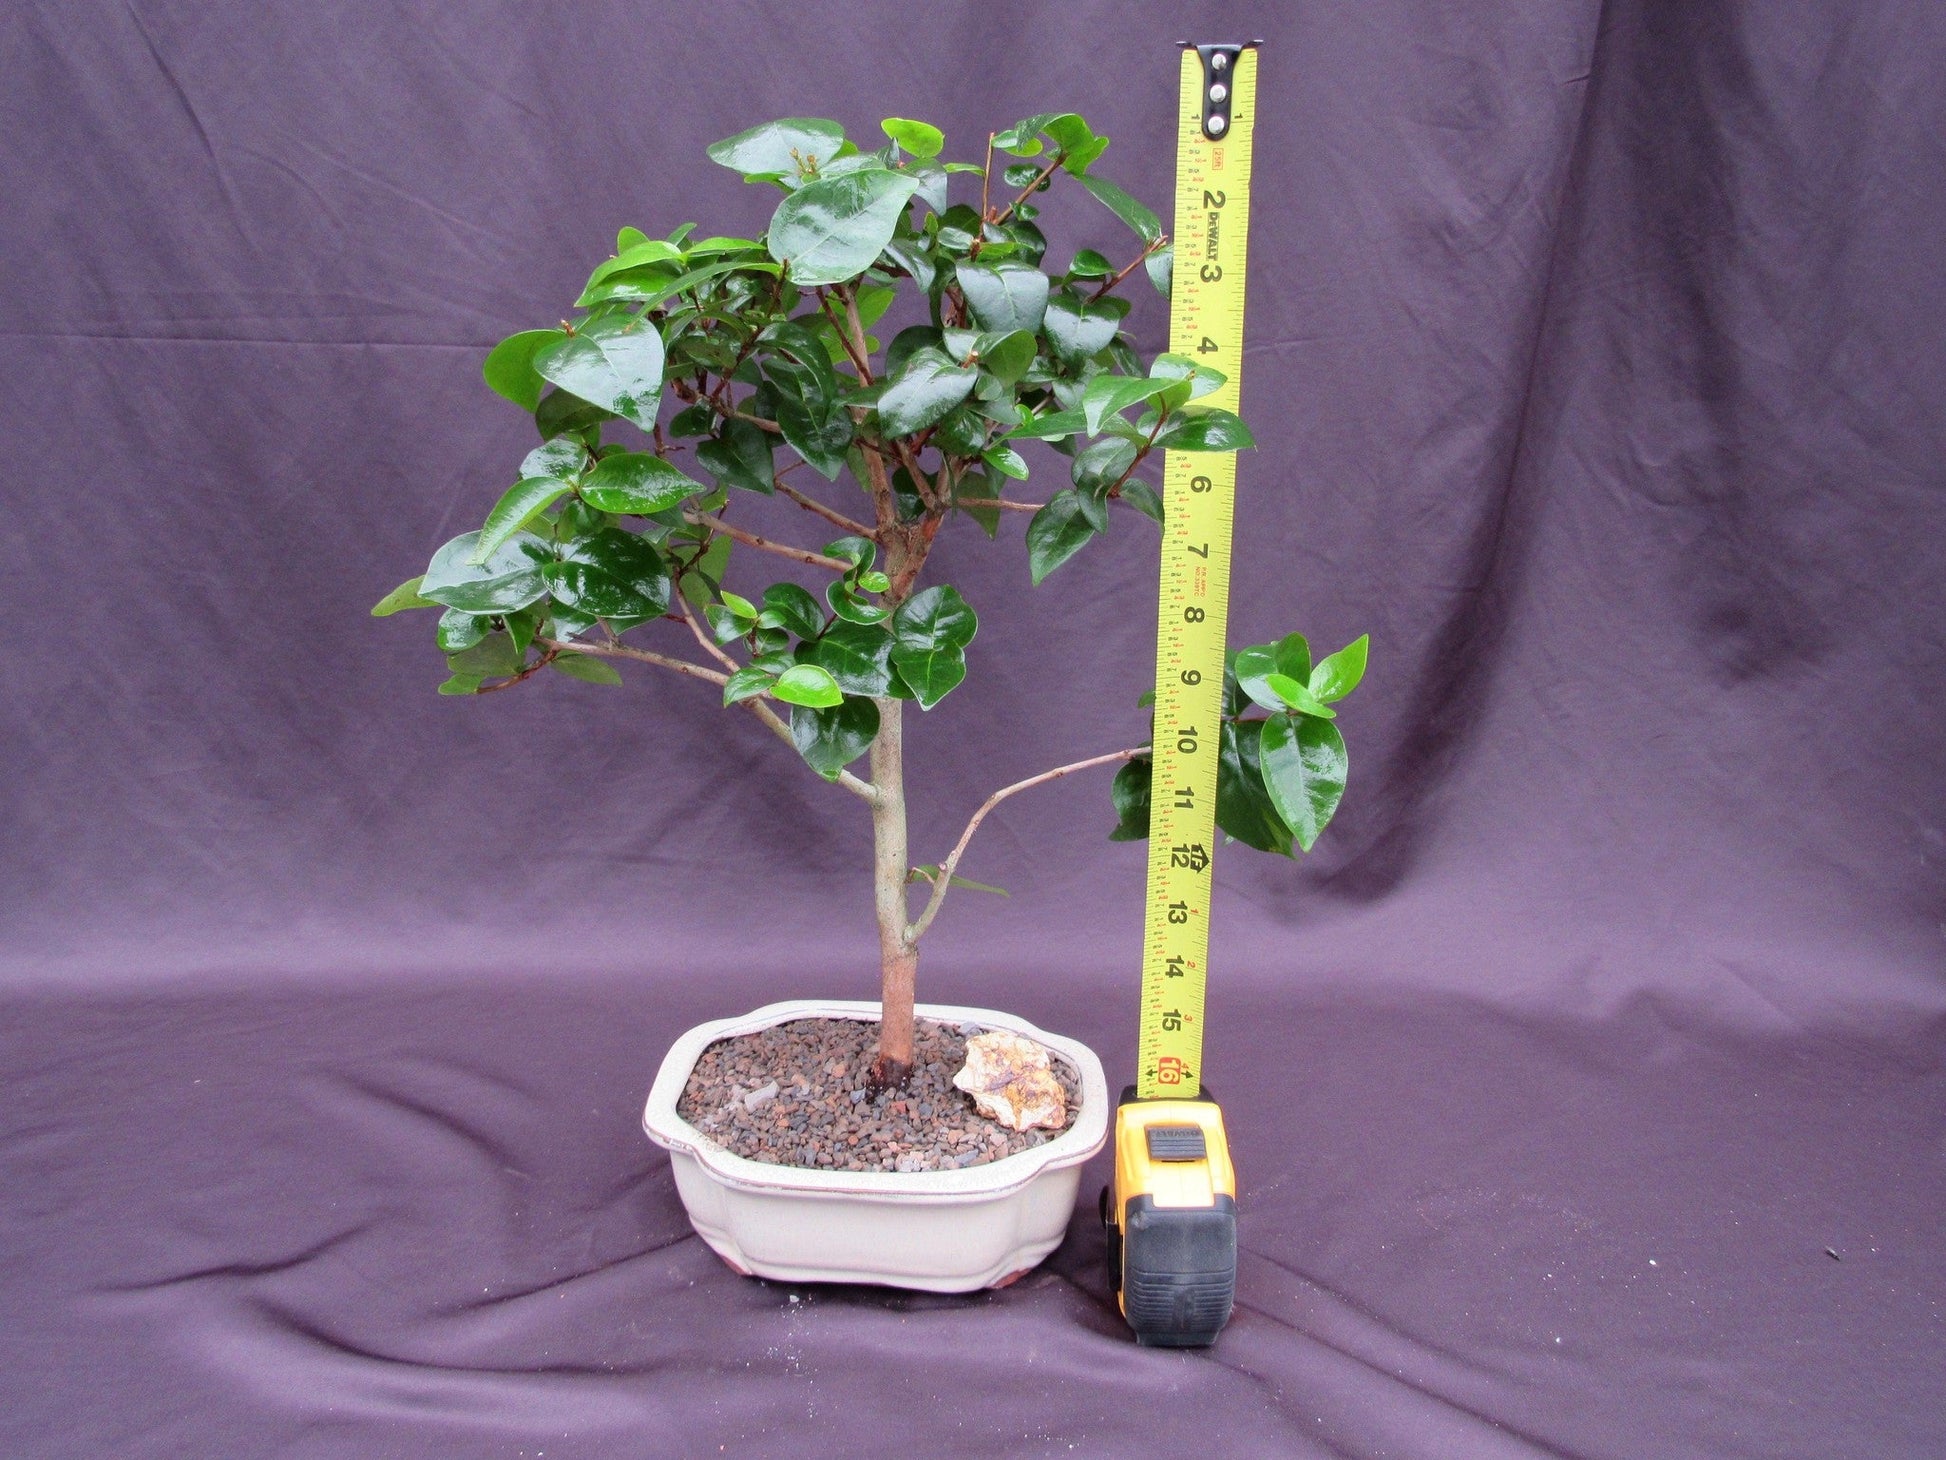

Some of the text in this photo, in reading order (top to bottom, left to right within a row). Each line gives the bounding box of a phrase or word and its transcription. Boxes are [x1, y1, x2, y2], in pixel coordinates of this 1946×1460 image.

[1203, 190, 1226, 209] 2
[1200, 264, 1223, 283] 3
[1197, 336, 1218, 354] 4
[1190, 476, 1212, 493] 6
[1187, 543, 1208, 559] 7
[1184, 606, 1205, 623] 8
[1181, 670, 1201, 686] 9
[1177, 726, 1198, 754] 10
[1174, 786, 1194, 809] 11
[1171, 843, 1190, 868] 12
[1168, 900, 1188, 924] 13
[1165, 955, 1184, 978] 14
[1162, 1008, 1181, 1032] 15
[1159, 1059, 1180, 1082] 16
